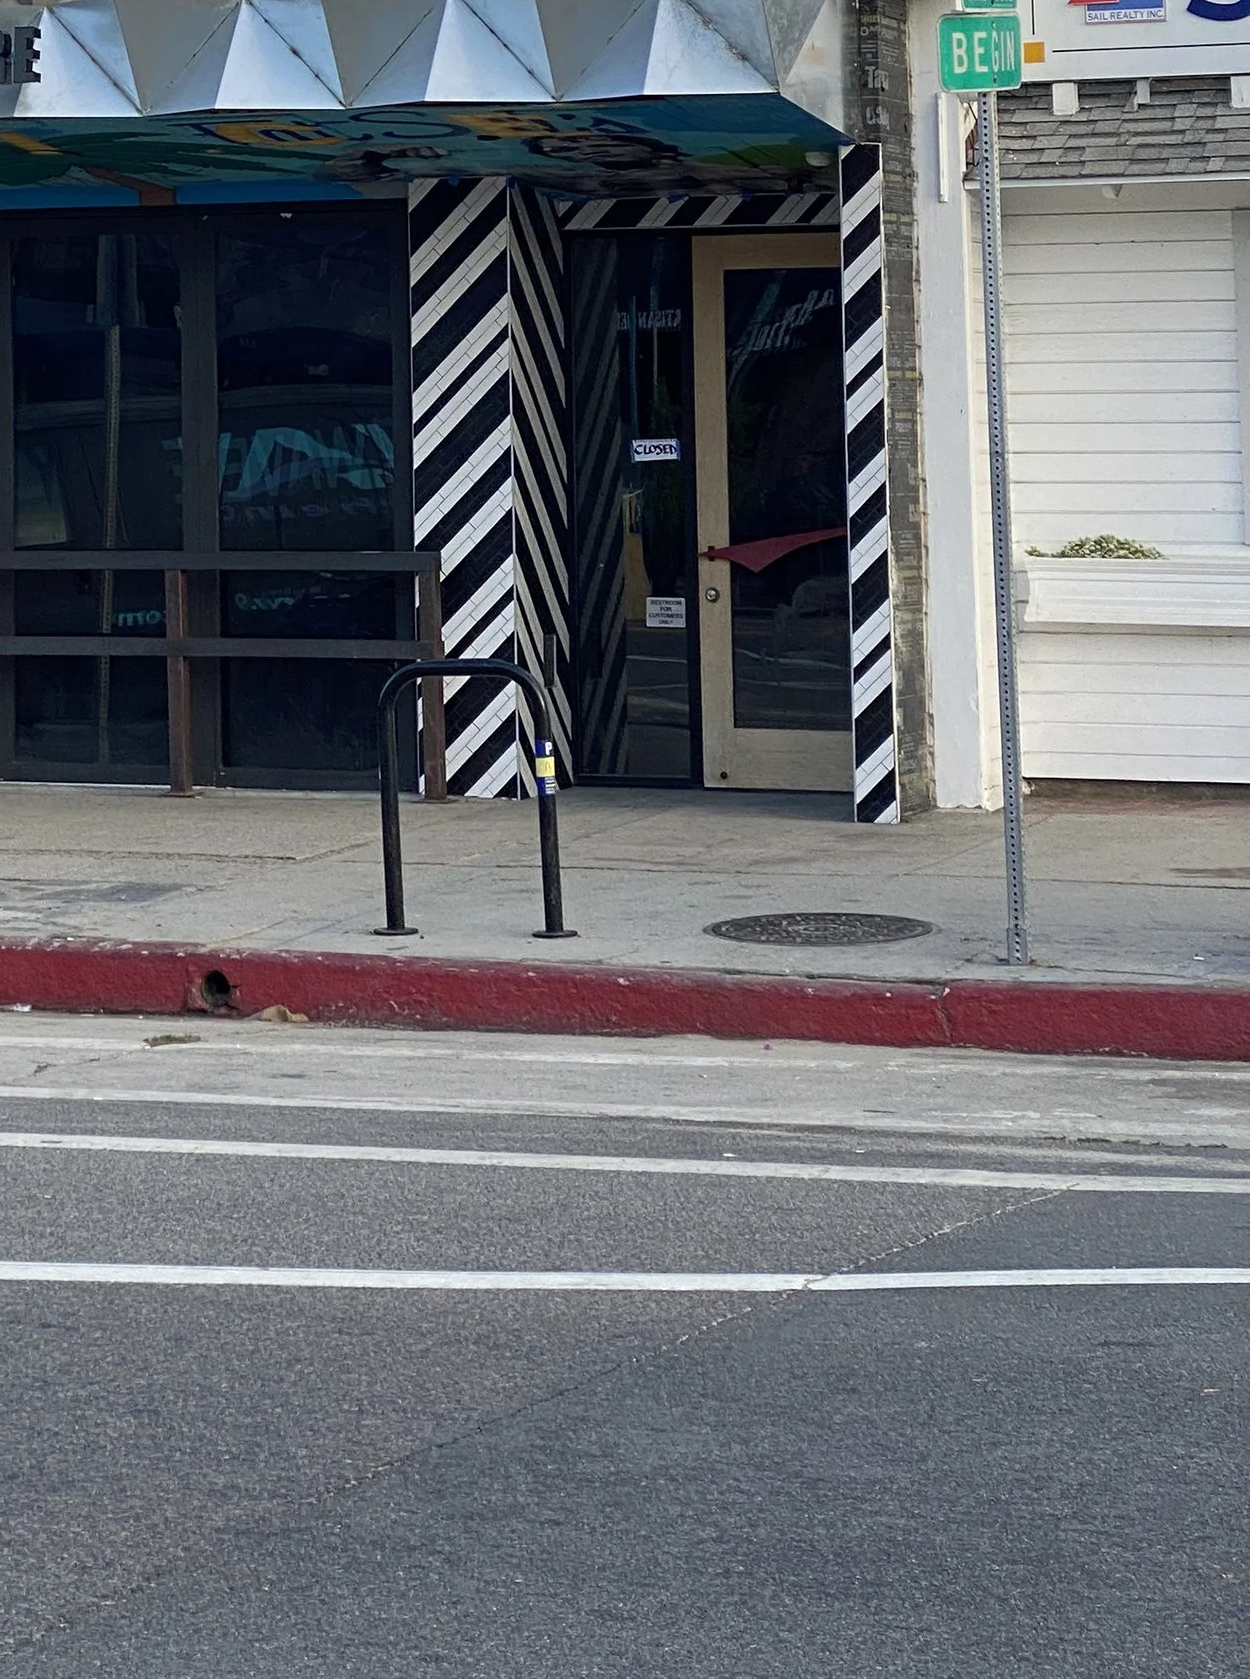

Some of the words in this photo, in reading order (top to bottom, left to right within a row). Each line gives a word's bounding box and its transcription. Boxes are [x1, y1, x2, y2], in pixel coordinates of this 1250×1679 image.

[1087, 11, 1109, 21] SAIL
[1110, 10, 1146, 20] REALTY
[1147, 9, 1164, 18] INC.
[952, 30, 1015, 74] BEGIN
[634, 443, 678, 456] CLOSED
